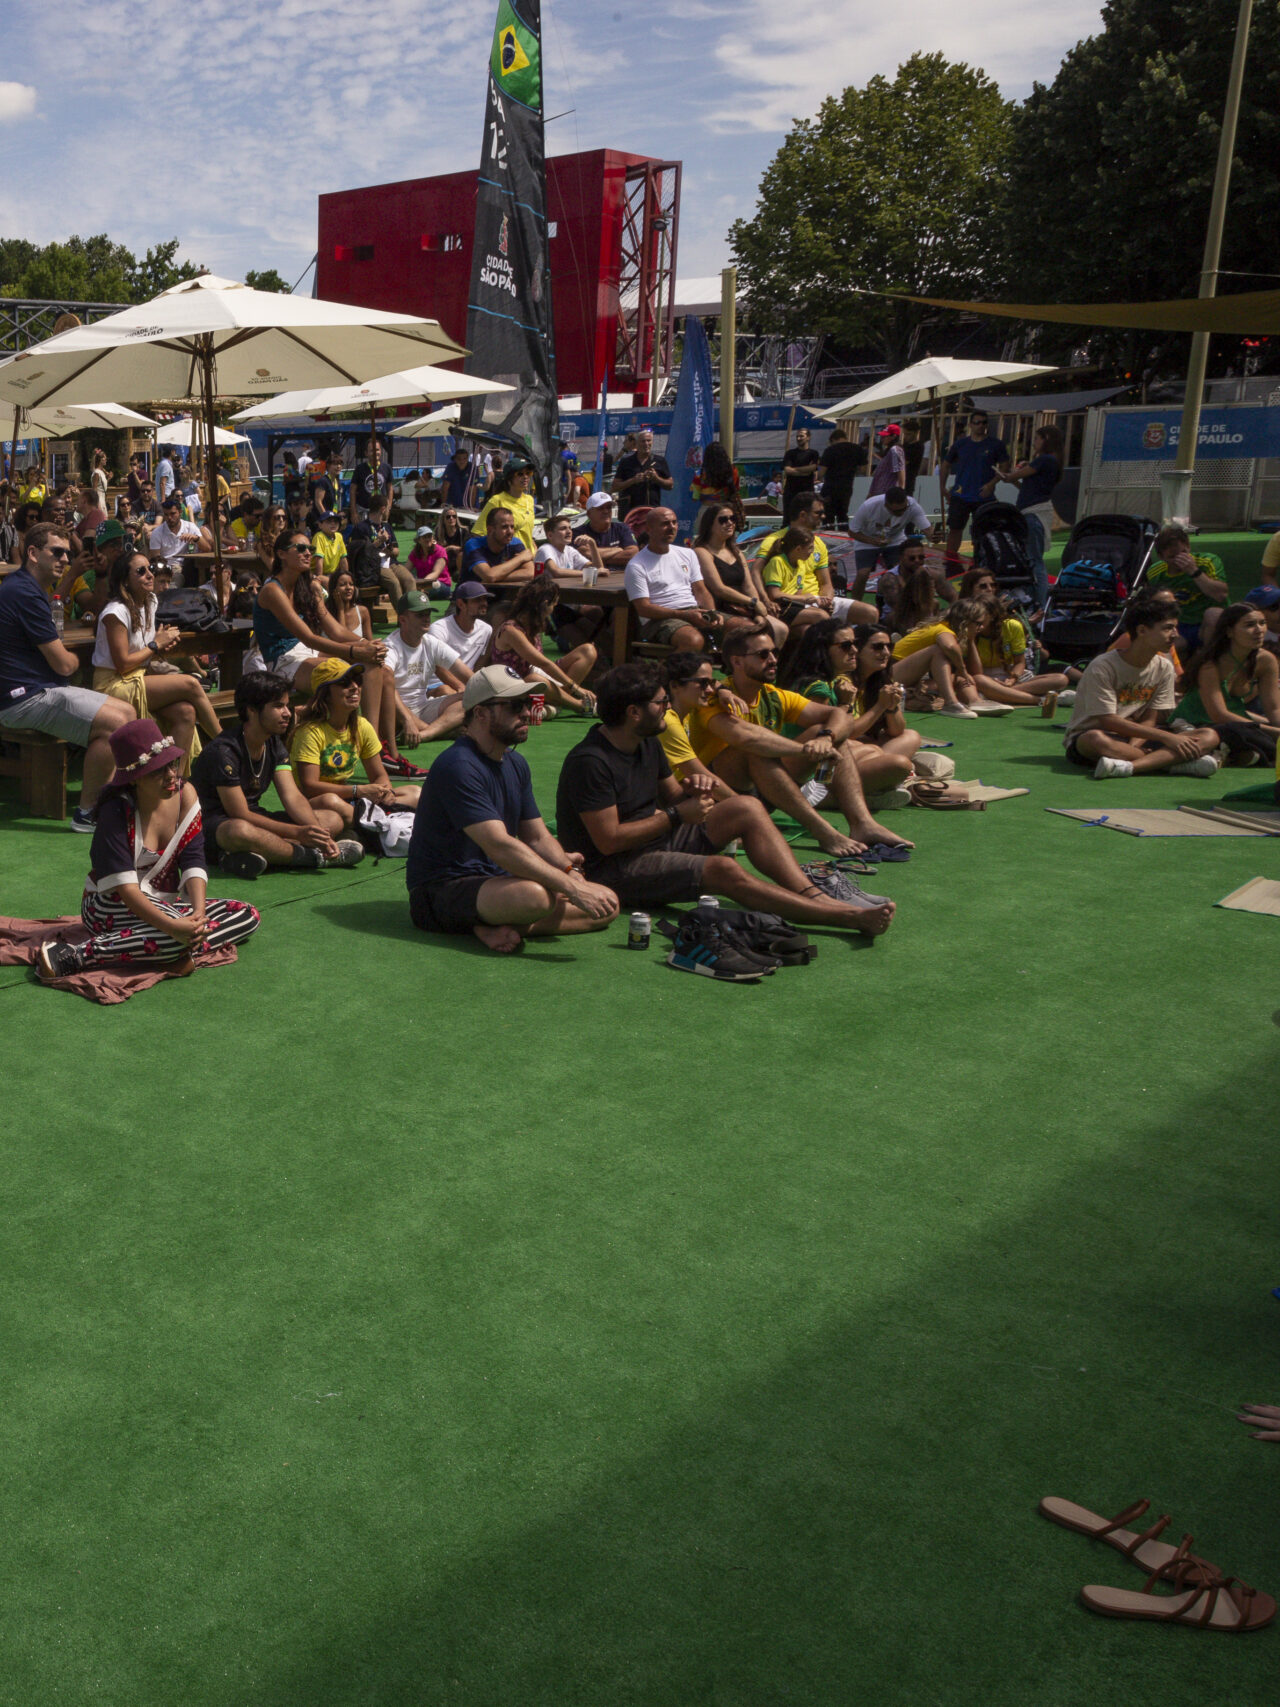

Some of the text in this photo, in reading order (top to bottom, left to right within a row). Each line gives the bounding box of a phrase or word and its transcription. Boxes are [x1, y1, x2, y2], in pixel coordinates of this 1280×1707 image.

[1169, 424, 1227, 434] CIDE DE
[1199, 433, 1244, 445] PAULO
